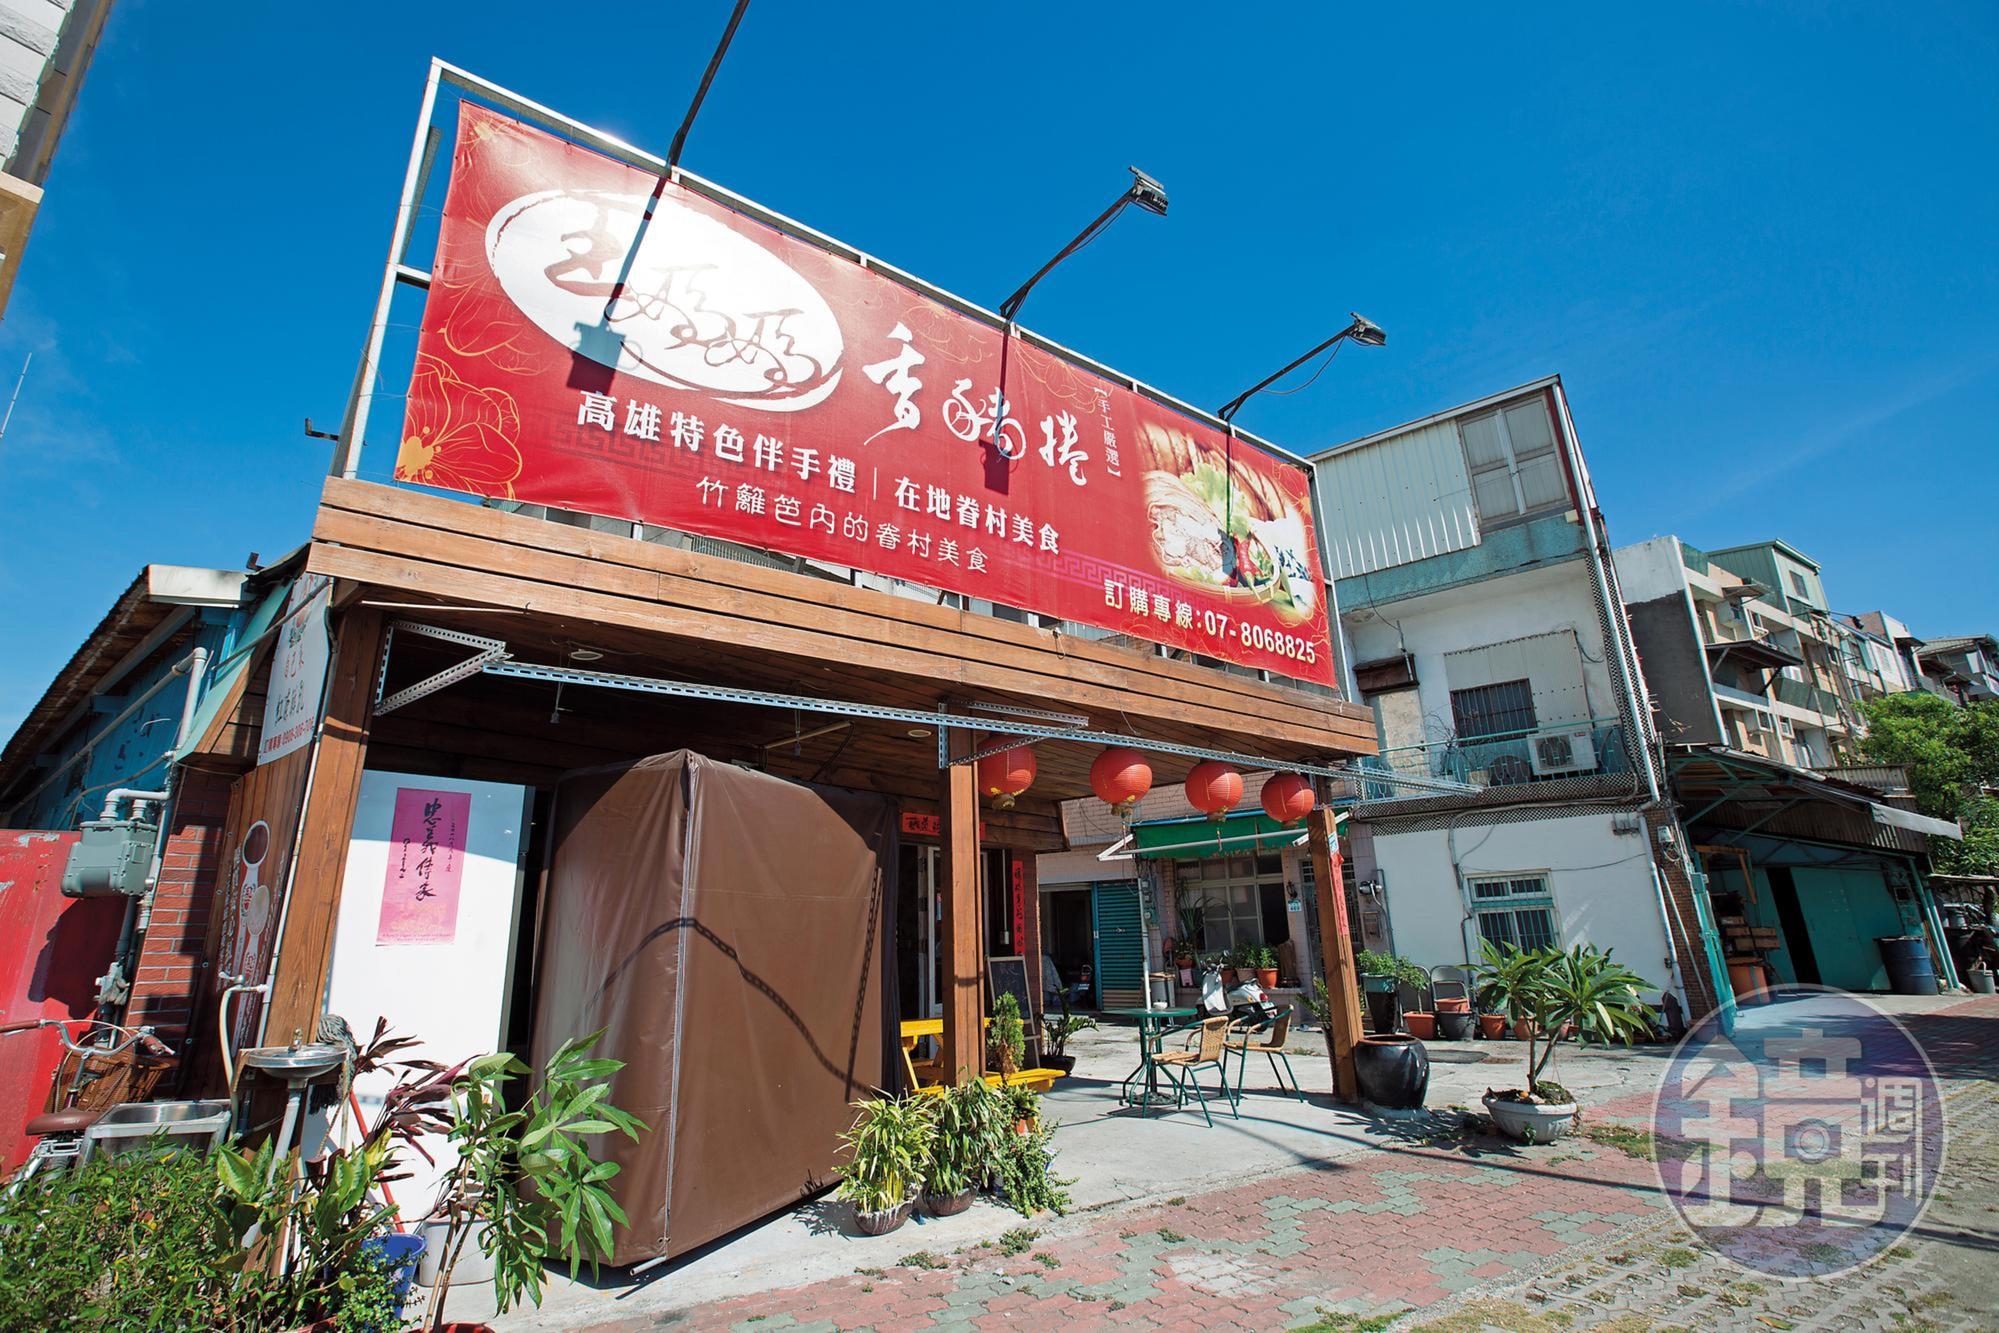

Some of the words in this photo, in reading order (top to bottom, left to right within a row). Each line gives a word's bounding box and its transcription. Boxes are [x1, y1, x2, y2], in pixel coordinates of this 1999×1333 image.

[577, 391, 856, 495] 高雄特色伴手禮
[894, 476, 1061, 557] 在地眷村美食
[696, 475, 989, 575] 竹籬笆內的眷村美食
